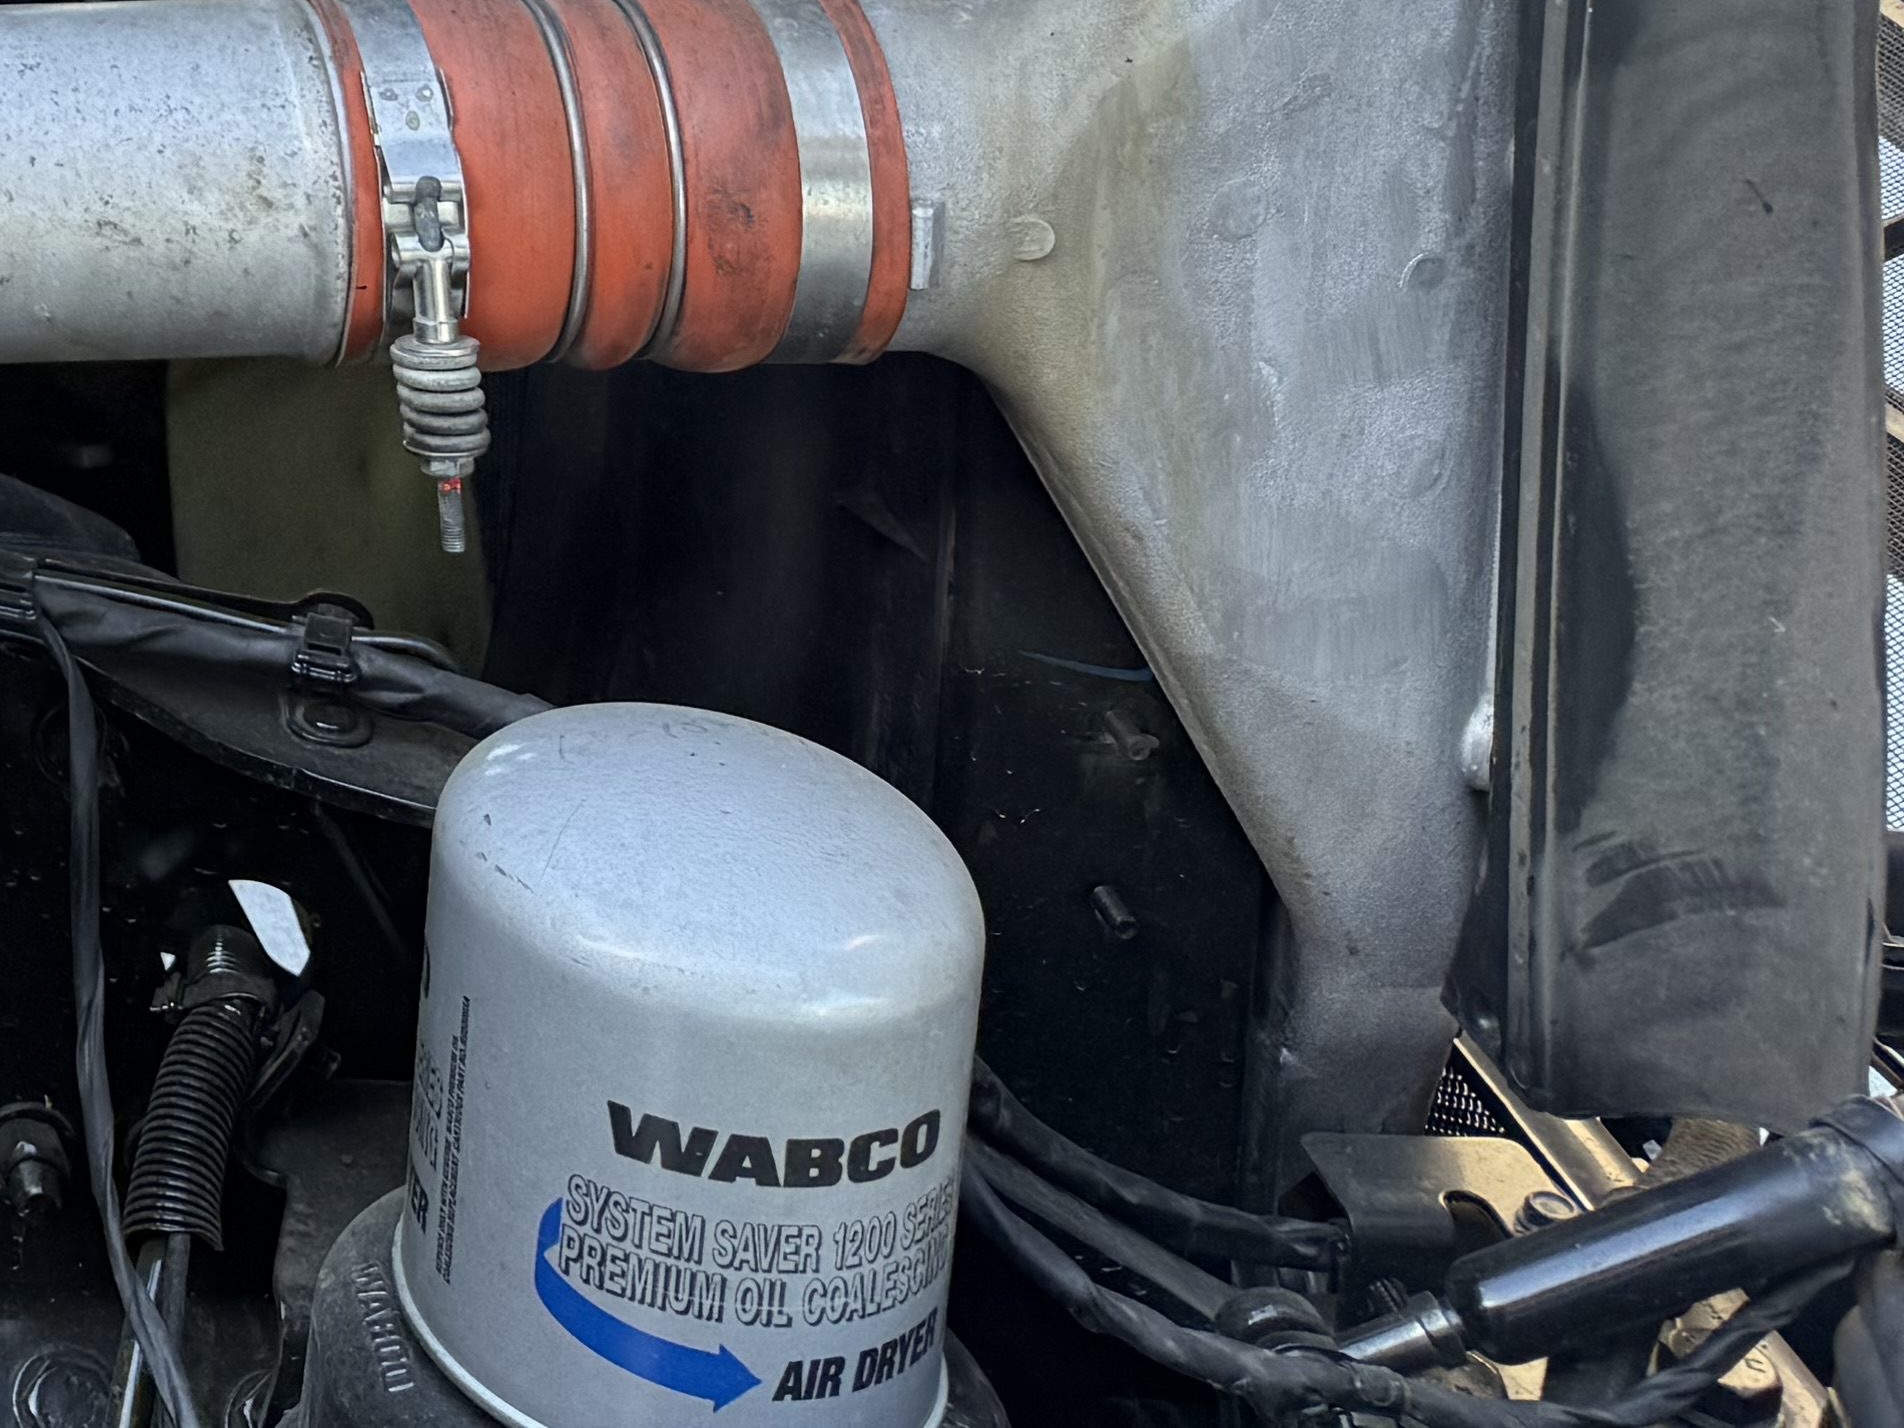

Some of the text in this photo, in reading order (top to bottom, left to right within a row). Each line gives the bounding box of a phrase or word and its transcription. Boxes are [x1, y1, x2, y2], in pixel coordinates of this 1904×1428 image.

[606, 1099, 942, 1189] WABCO
[565, 1173, 707, 1266] SYSTEM
[711, 1218, 822, 1275] SAVER
[832, 1211, 898, 1271] 1200
[557, 1222, 728, 1324] PREMIUM
[734, 1276, 793, 1328] OIL
[771, 1306, 938, 1403] AIR DRYER
